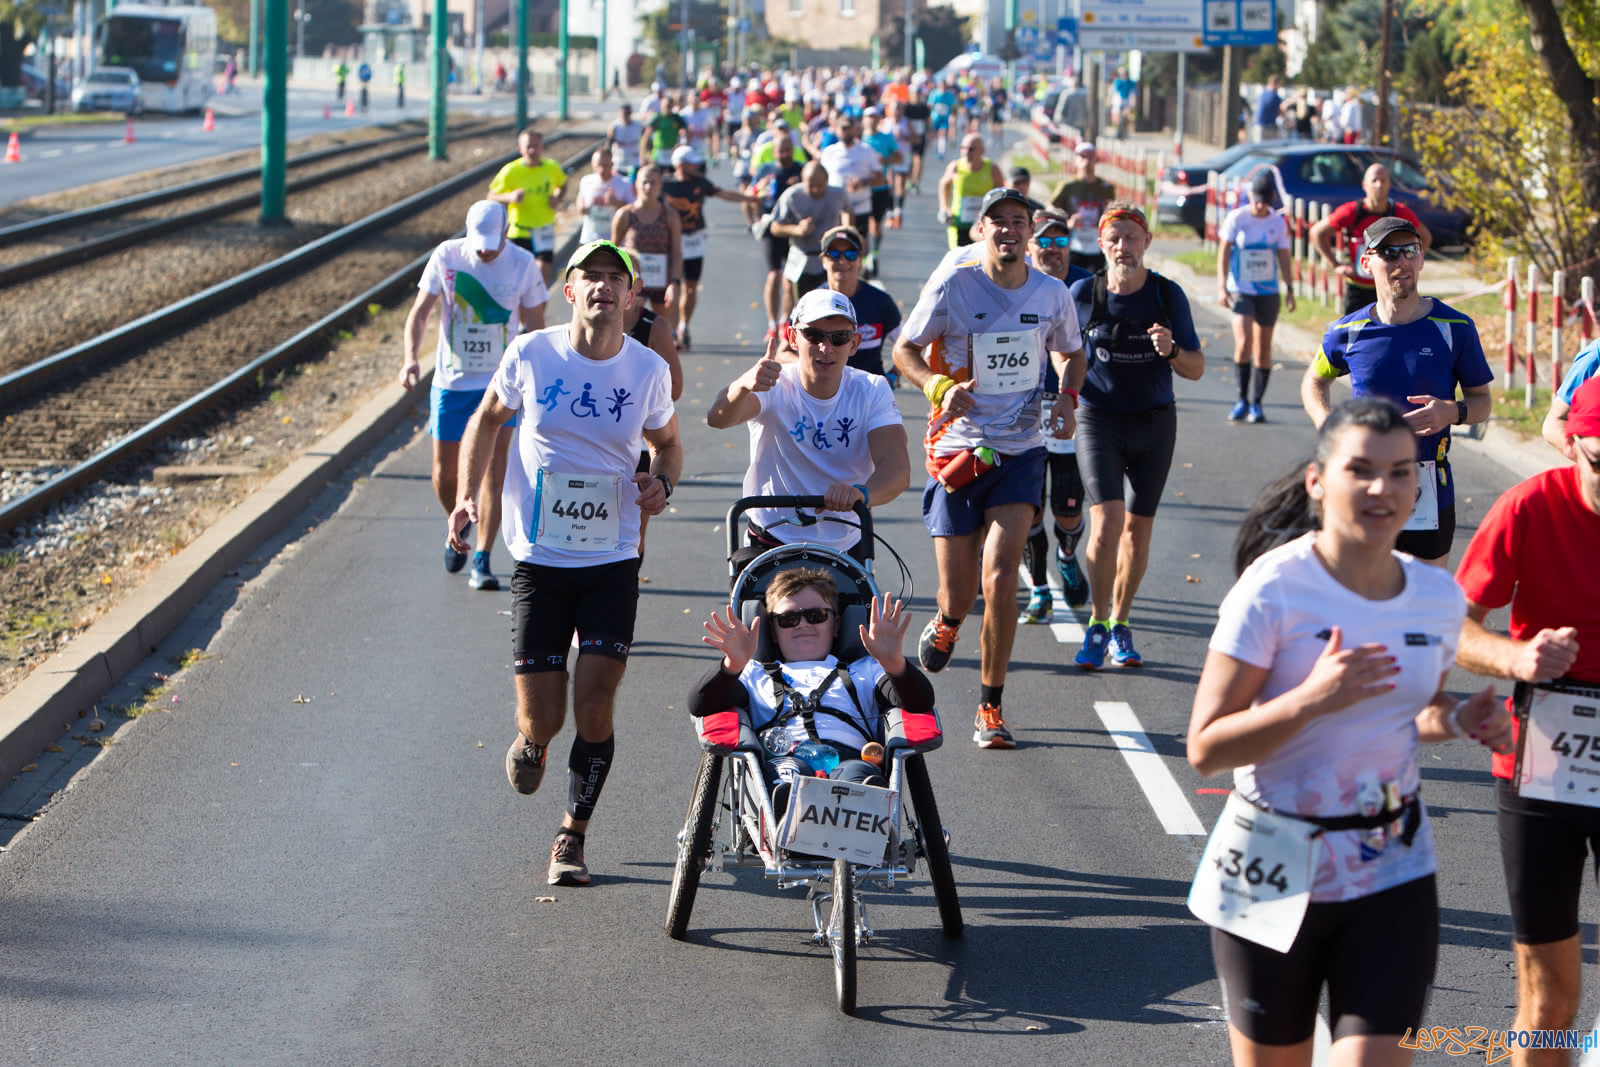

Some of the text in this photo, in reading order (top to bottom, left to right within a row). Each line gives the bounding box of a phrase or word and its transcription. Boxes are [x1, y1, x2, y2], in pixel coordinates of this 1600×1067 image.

[463, 341, 491, 353] 1231
[987, 352, 1029, 370] 3766
[552, 499, 608, 520] 4404
[571, 523, 587, 531] Piotr
[577, 756, 606, 808] Kalenji
[800, 804, 890, 836] ANTEK
